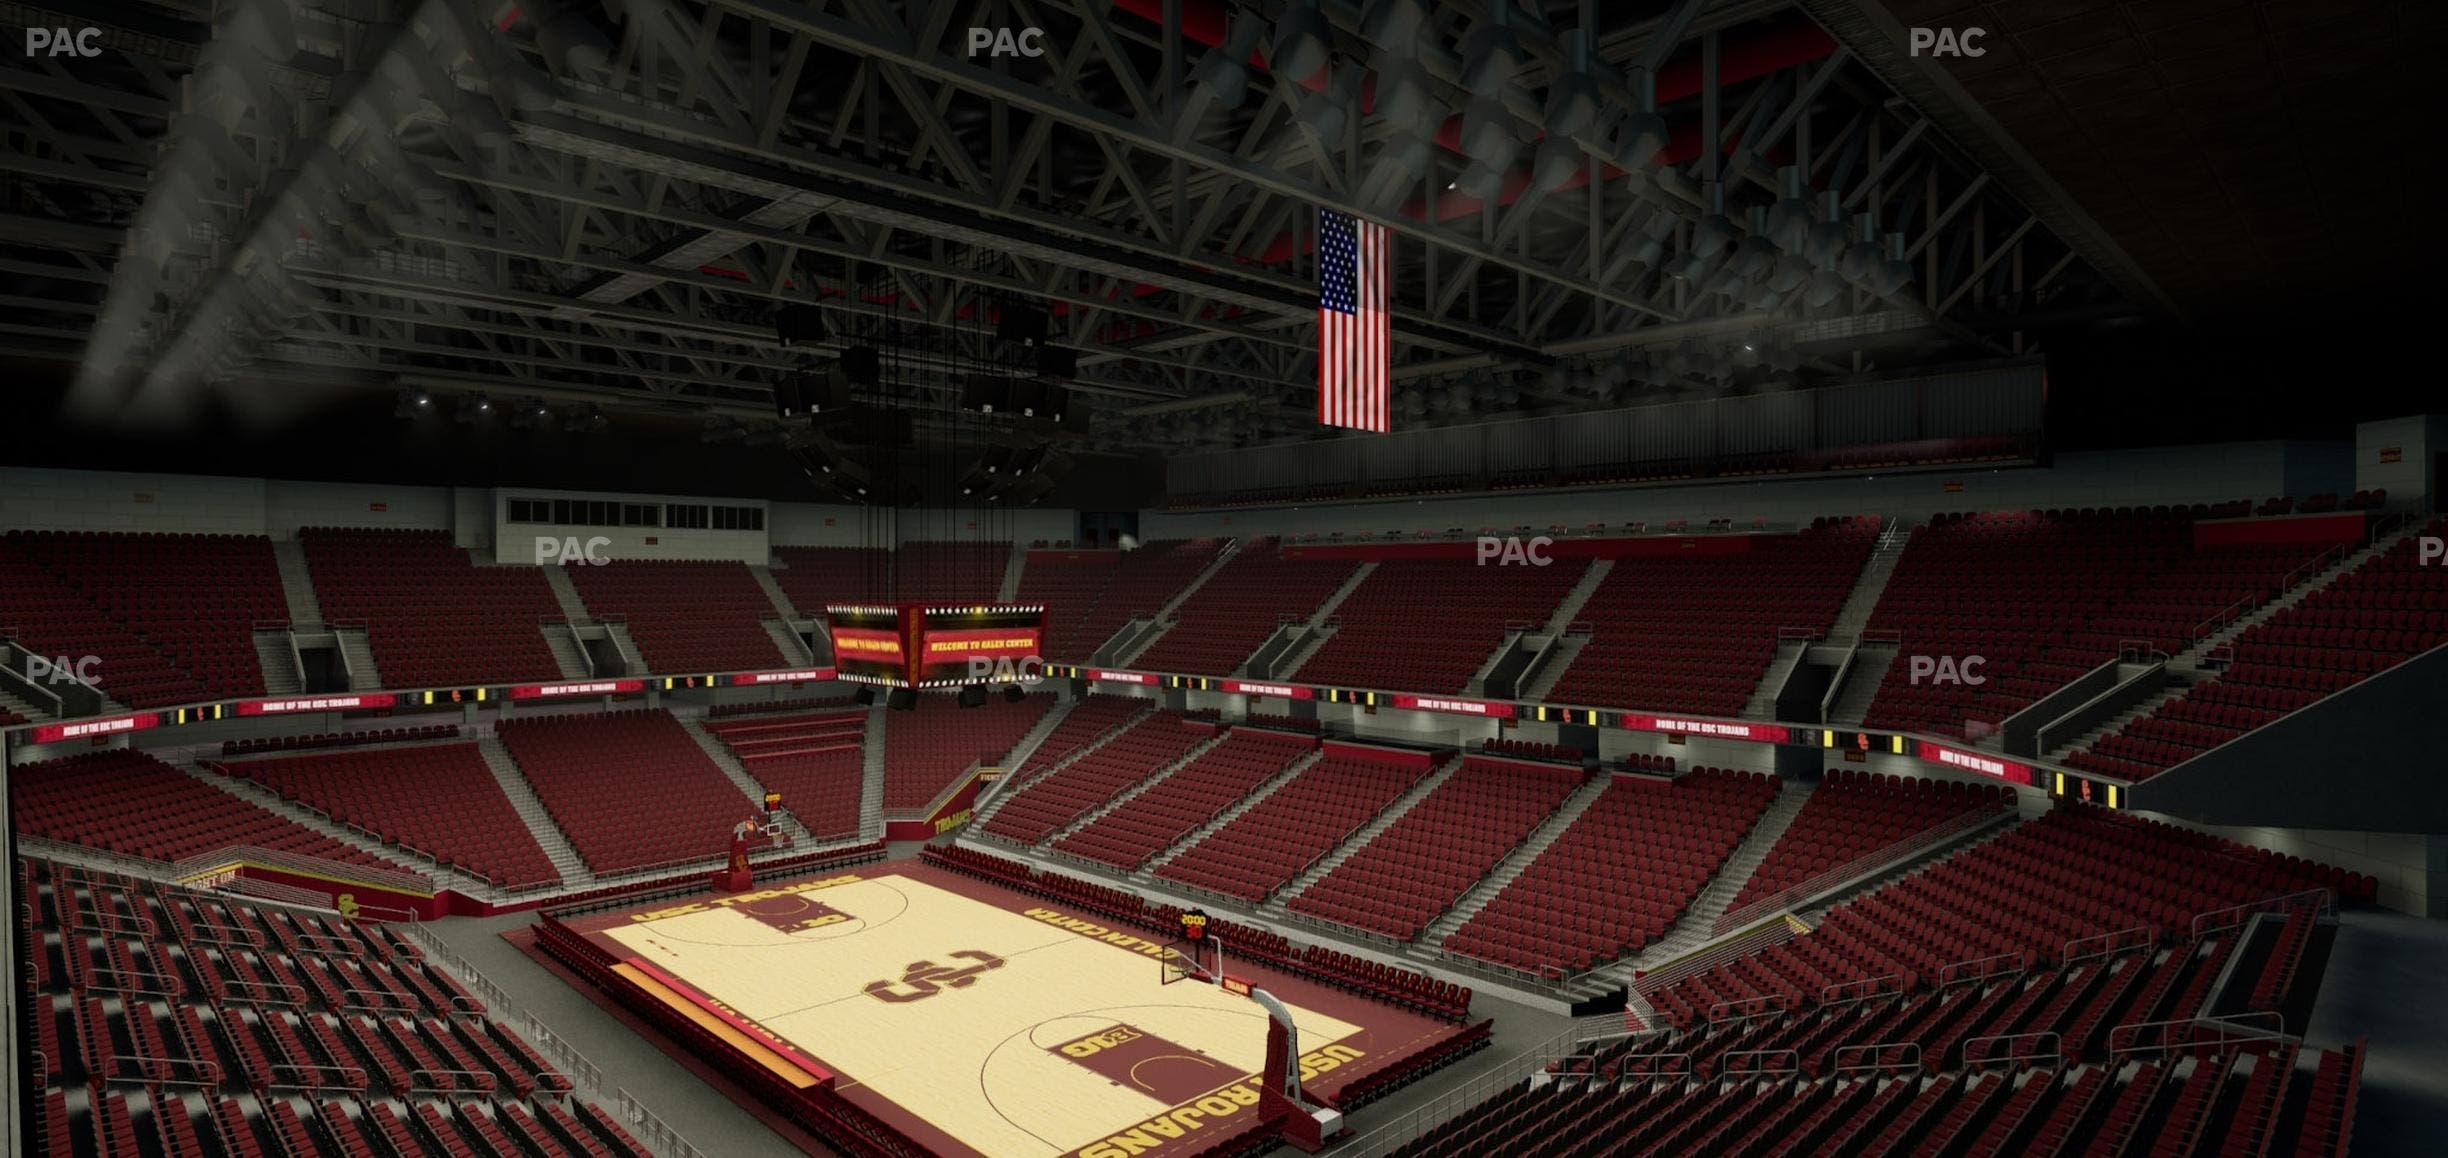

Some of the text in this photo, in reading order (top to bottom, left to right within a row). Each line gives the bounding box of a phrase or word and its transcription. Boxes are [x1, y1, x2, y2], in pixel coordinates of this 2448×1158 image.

[1656, 720, 1676, 729] HOME
[1677, 721, 1686, 730] OF
[1687, 722, 1700, 731] THE
[1717, 725, 1749, 736] TROJANS
[1078, 1076, 1264, 1158] ROJANS
